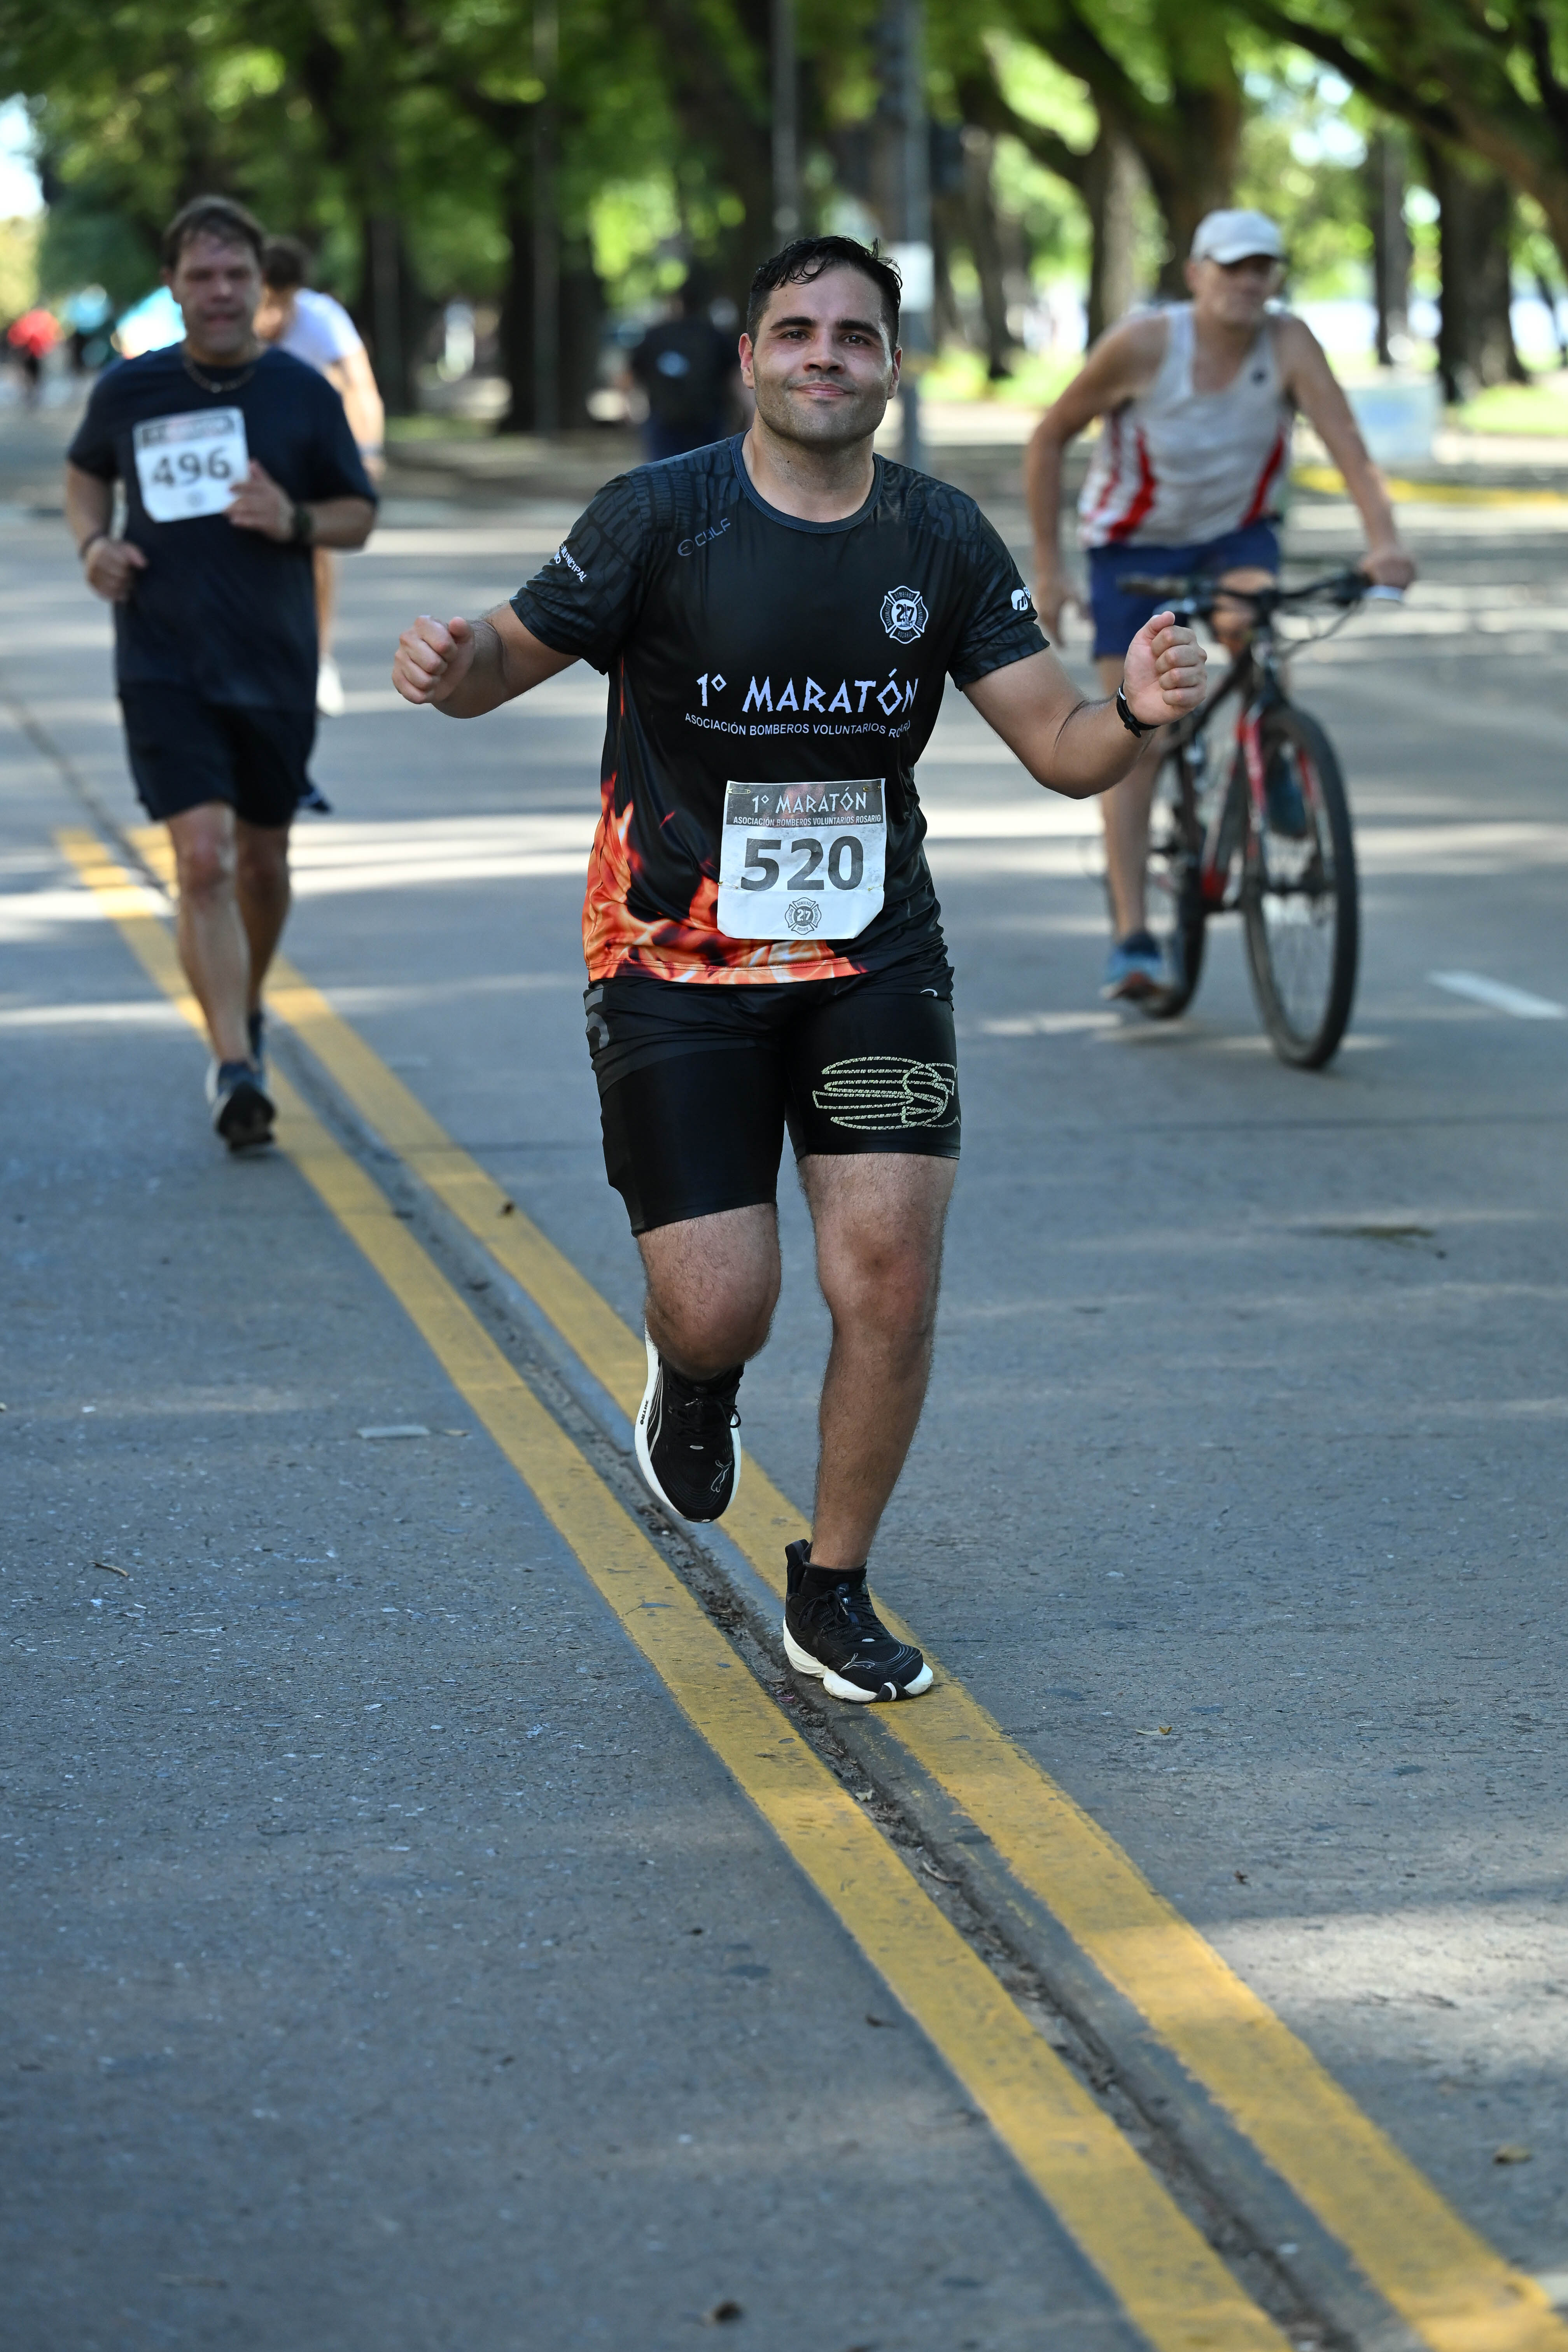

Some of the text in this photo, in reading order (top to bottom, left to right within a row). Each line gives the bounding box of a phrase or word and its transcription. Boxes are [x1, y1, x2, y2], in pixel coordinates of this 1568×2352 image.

[152, 446, 232, 487] 496
[561, 546, 587, 582] MUNICIPAL
[896, 603, 915, 622] 27
[742, 668, 918, 716] MARATÓN
[685, 713, 746, 735] ASOCIACIÓN
[750, 724, 809, 735] BOMBEROS
[813, 723, 886, 735] VOLUNTARIOS
[775, 786, 866, 814] MARATÓN
[733, 814, 881, 826] ASOCIACIÓN BOMBEROS VOLUNTARIOS ROSARIO
[740, 836, 863, 891] 520
[797, 908, 811, 921] 27
